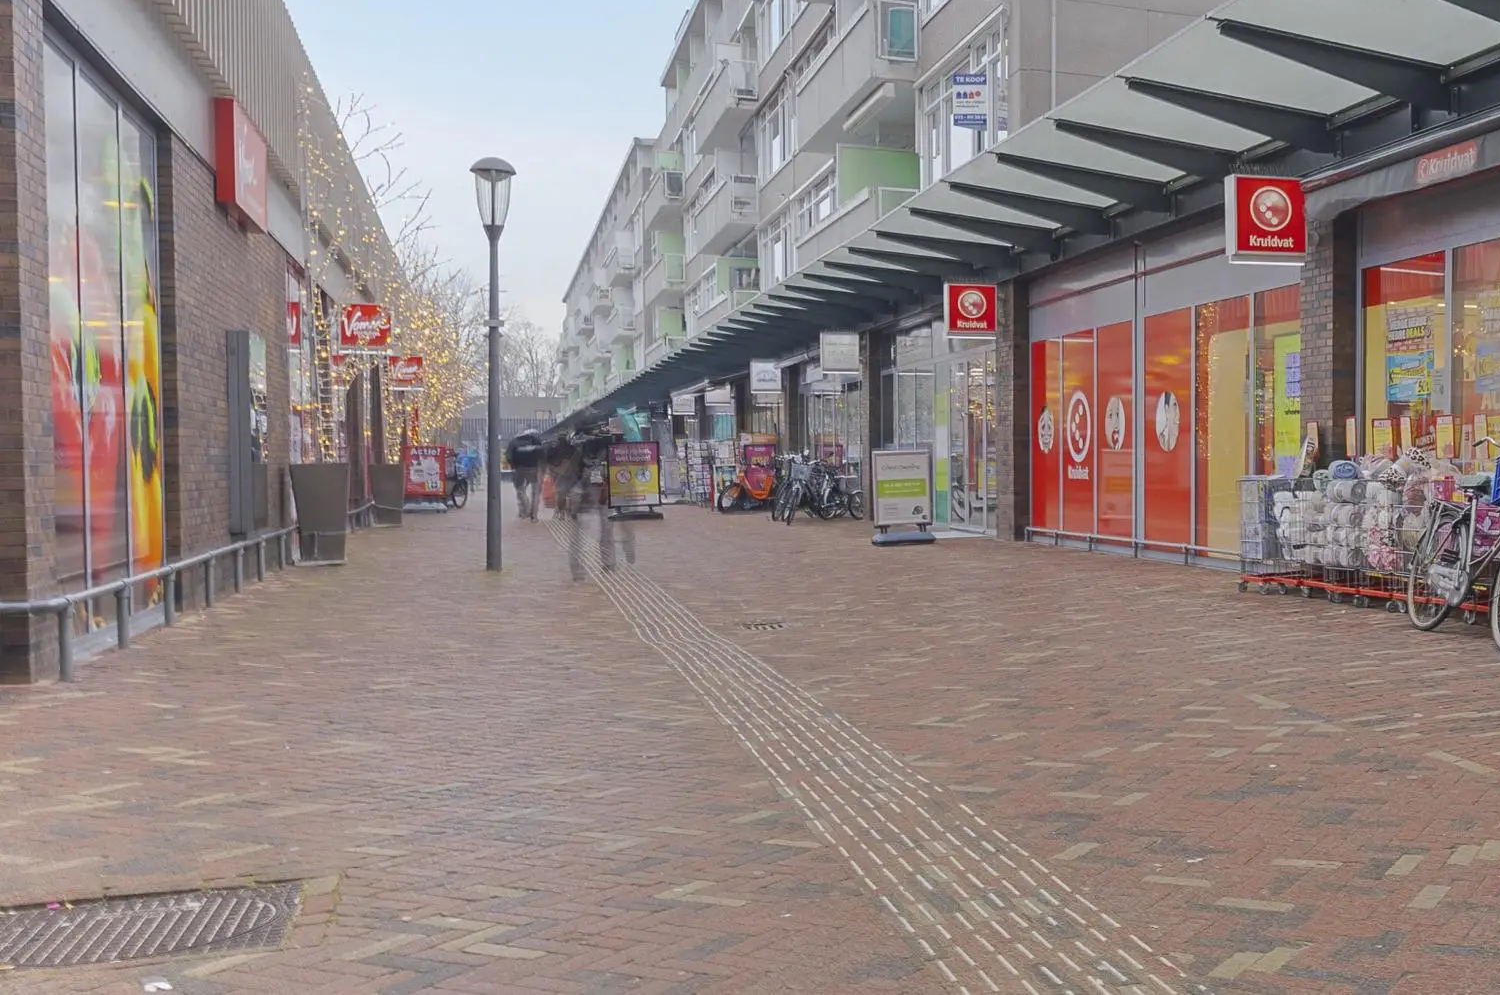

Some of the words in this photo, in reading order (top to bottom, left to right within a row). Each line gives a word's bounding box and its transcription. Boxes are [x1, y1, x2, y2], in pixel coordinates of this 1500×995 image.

[1428, 147, 1476, 175] Kruidvat
[1249, 234, 1294, 249] Kruidvat
[957, 318, 987, 329] Kruidvat
